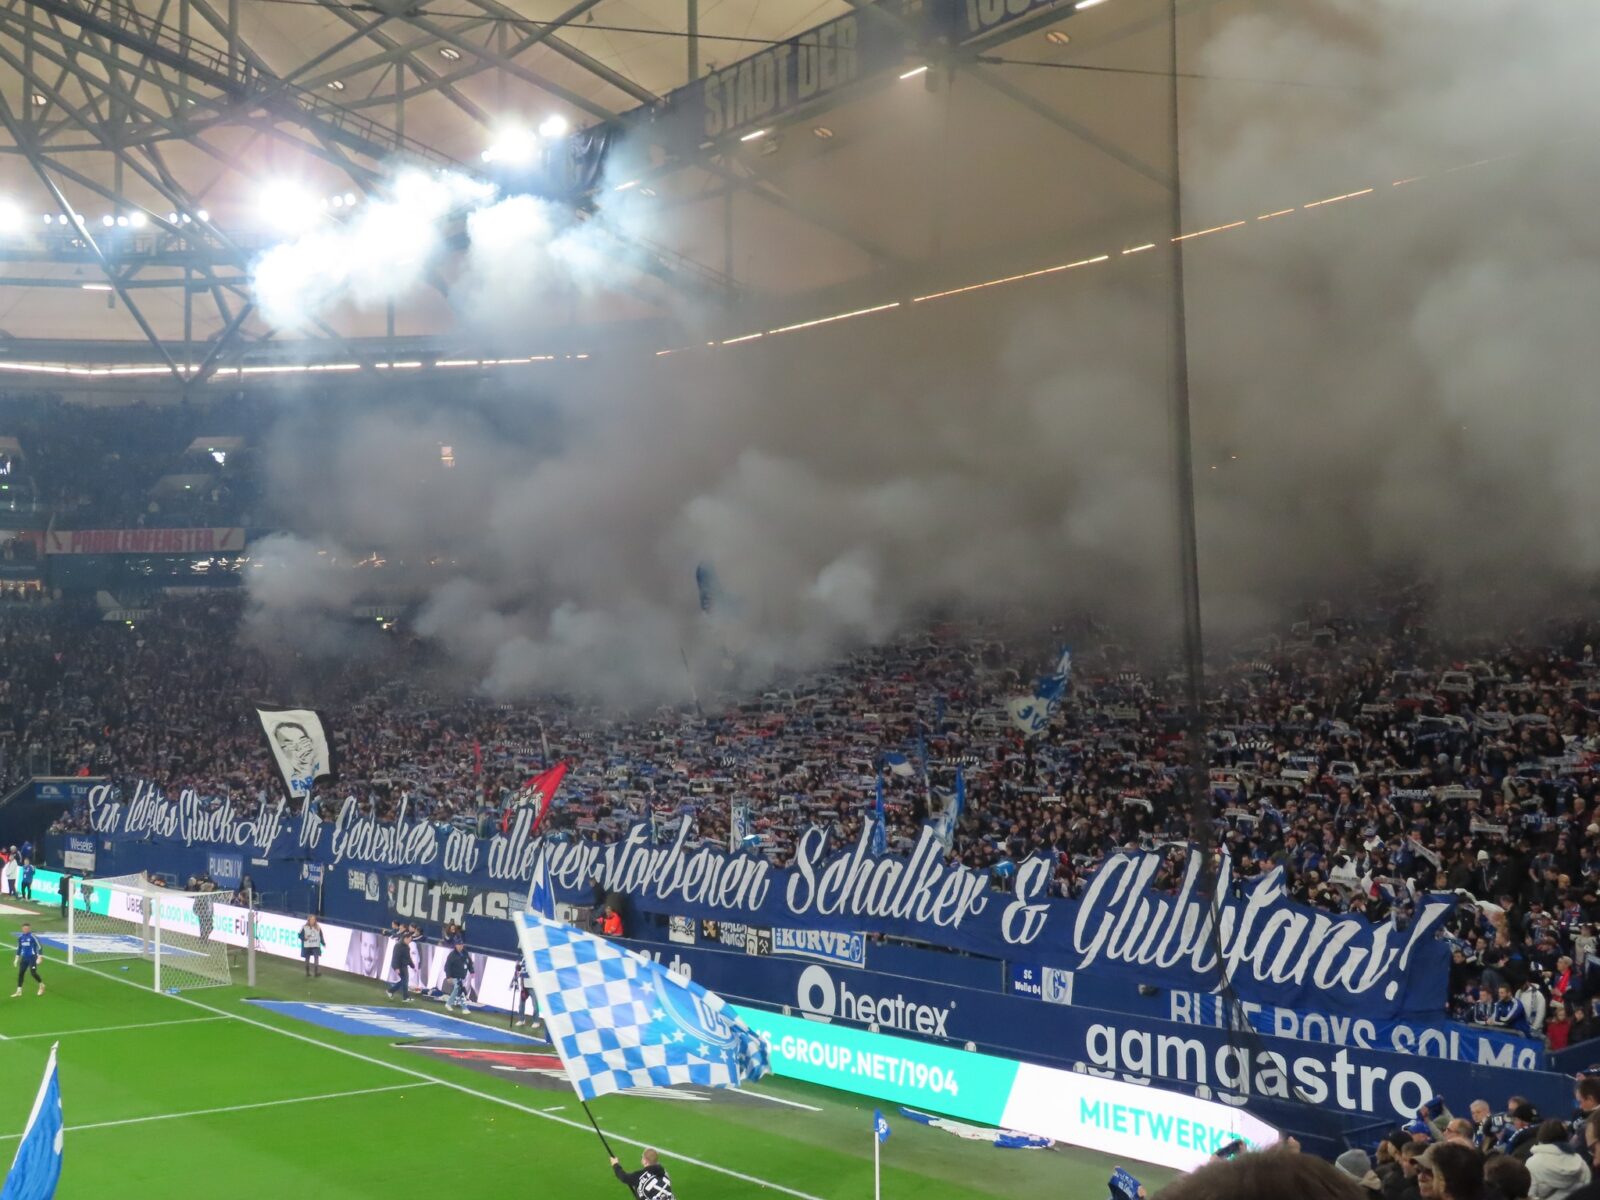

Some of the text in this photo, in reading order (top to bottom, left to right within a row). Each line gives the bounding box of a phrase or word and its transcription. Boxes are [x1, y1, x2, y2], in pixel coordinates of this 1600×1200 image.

[704, 15, 858, 137] STADT DER
[70, 837, 94, 852] Weseke
[88, 784, 121, 834] Ein
[125, 779, 179, 840] letztes
[332, 791, 438, 865] Gedenken
[444, 831, 479, 875] an
[543, 815, 771, 912] verstorbenen
[786, 815, 989, 930] Schalker
[1001, 852, 1052, 945] &
[782, 928, 850, 958] KURVE
[1023, 968, 1034, 980] SC
[1033, 984, 1042, 995] 04
[840, 980, 950, 1038] heatrex
[757, 1028, 960, 1097] S-GROUP.NET/1904
[1085, 1022, 1434, 1119] ggmgastro
[1080, 1096, 1243, 1157] MIETWERK
